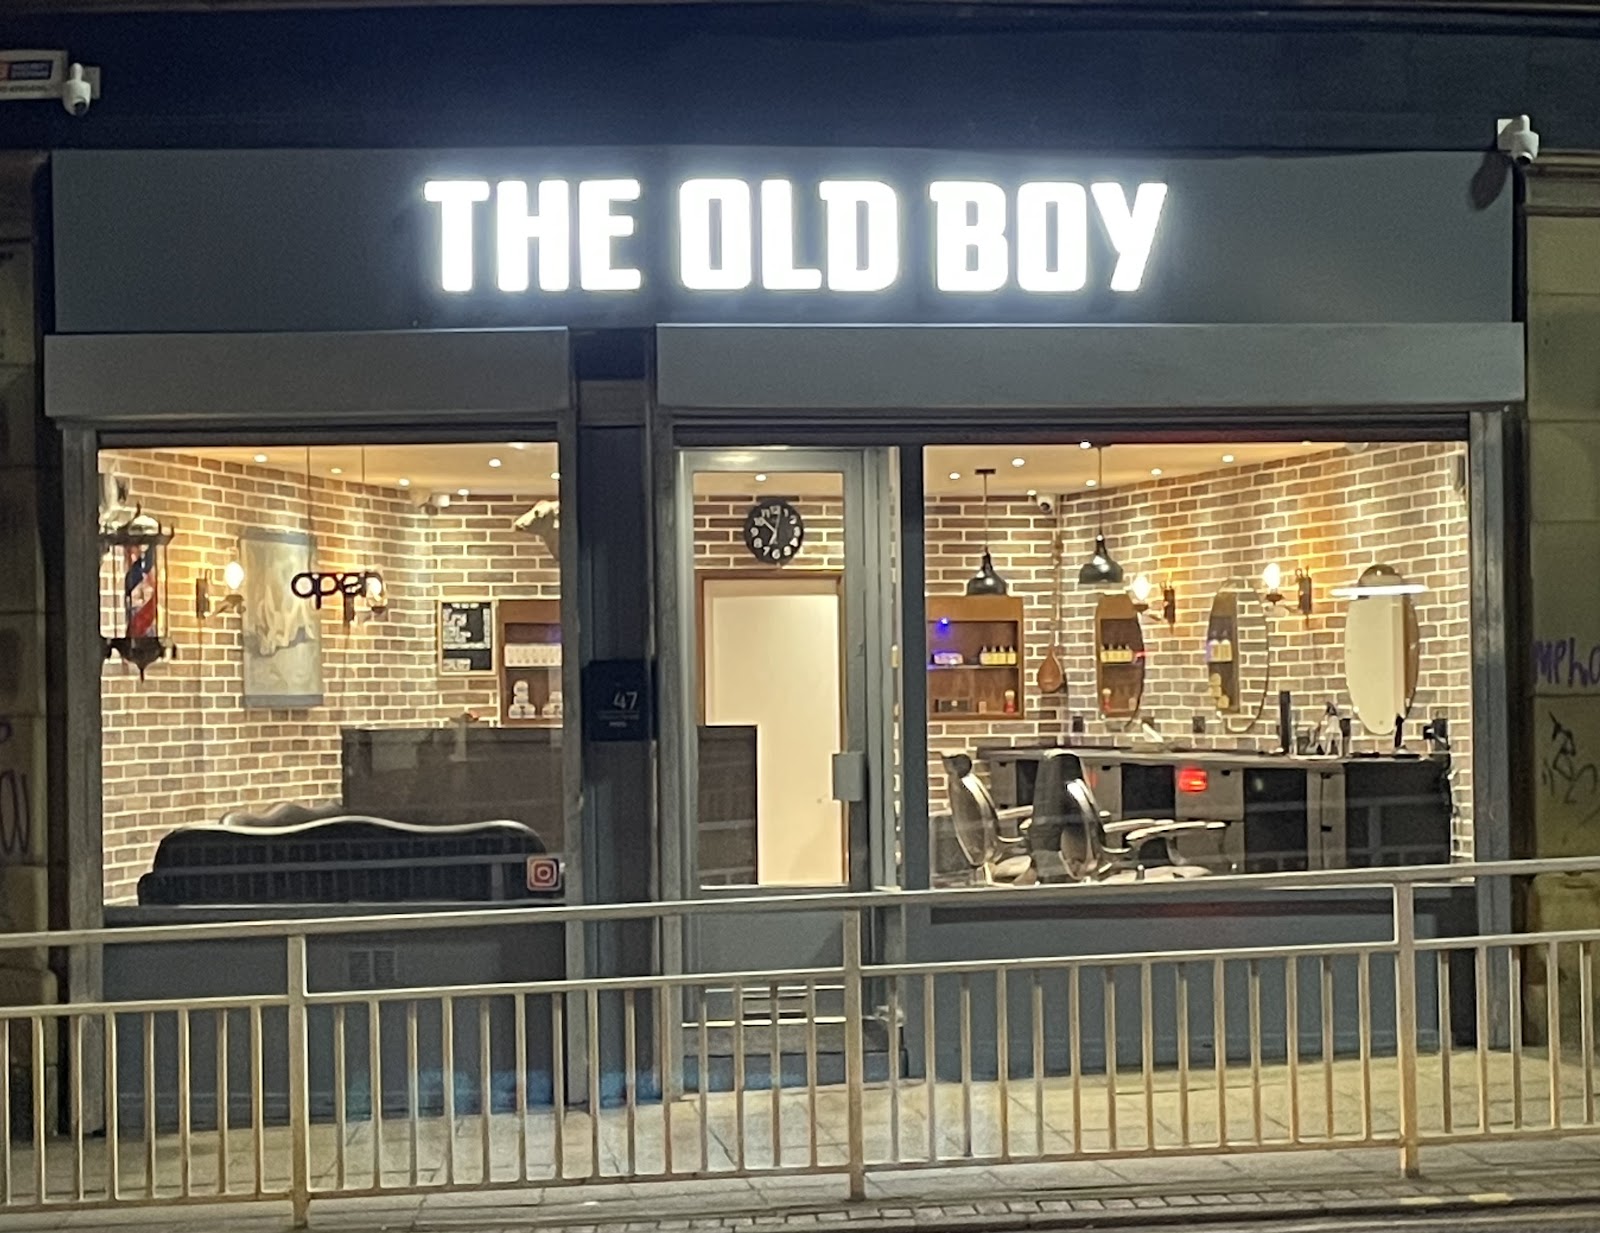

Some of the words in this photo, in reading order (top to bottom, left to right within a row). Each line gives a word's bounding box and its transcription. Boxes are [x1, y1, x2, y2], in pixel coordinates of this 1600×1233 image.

[423, 178, 642, 292] THE
[678, 178, 900, 292] OLD
[929, 180, 1169, 292] BOY
[291, 572, 384, 610] open
[613, 691, 638, 710] 47
